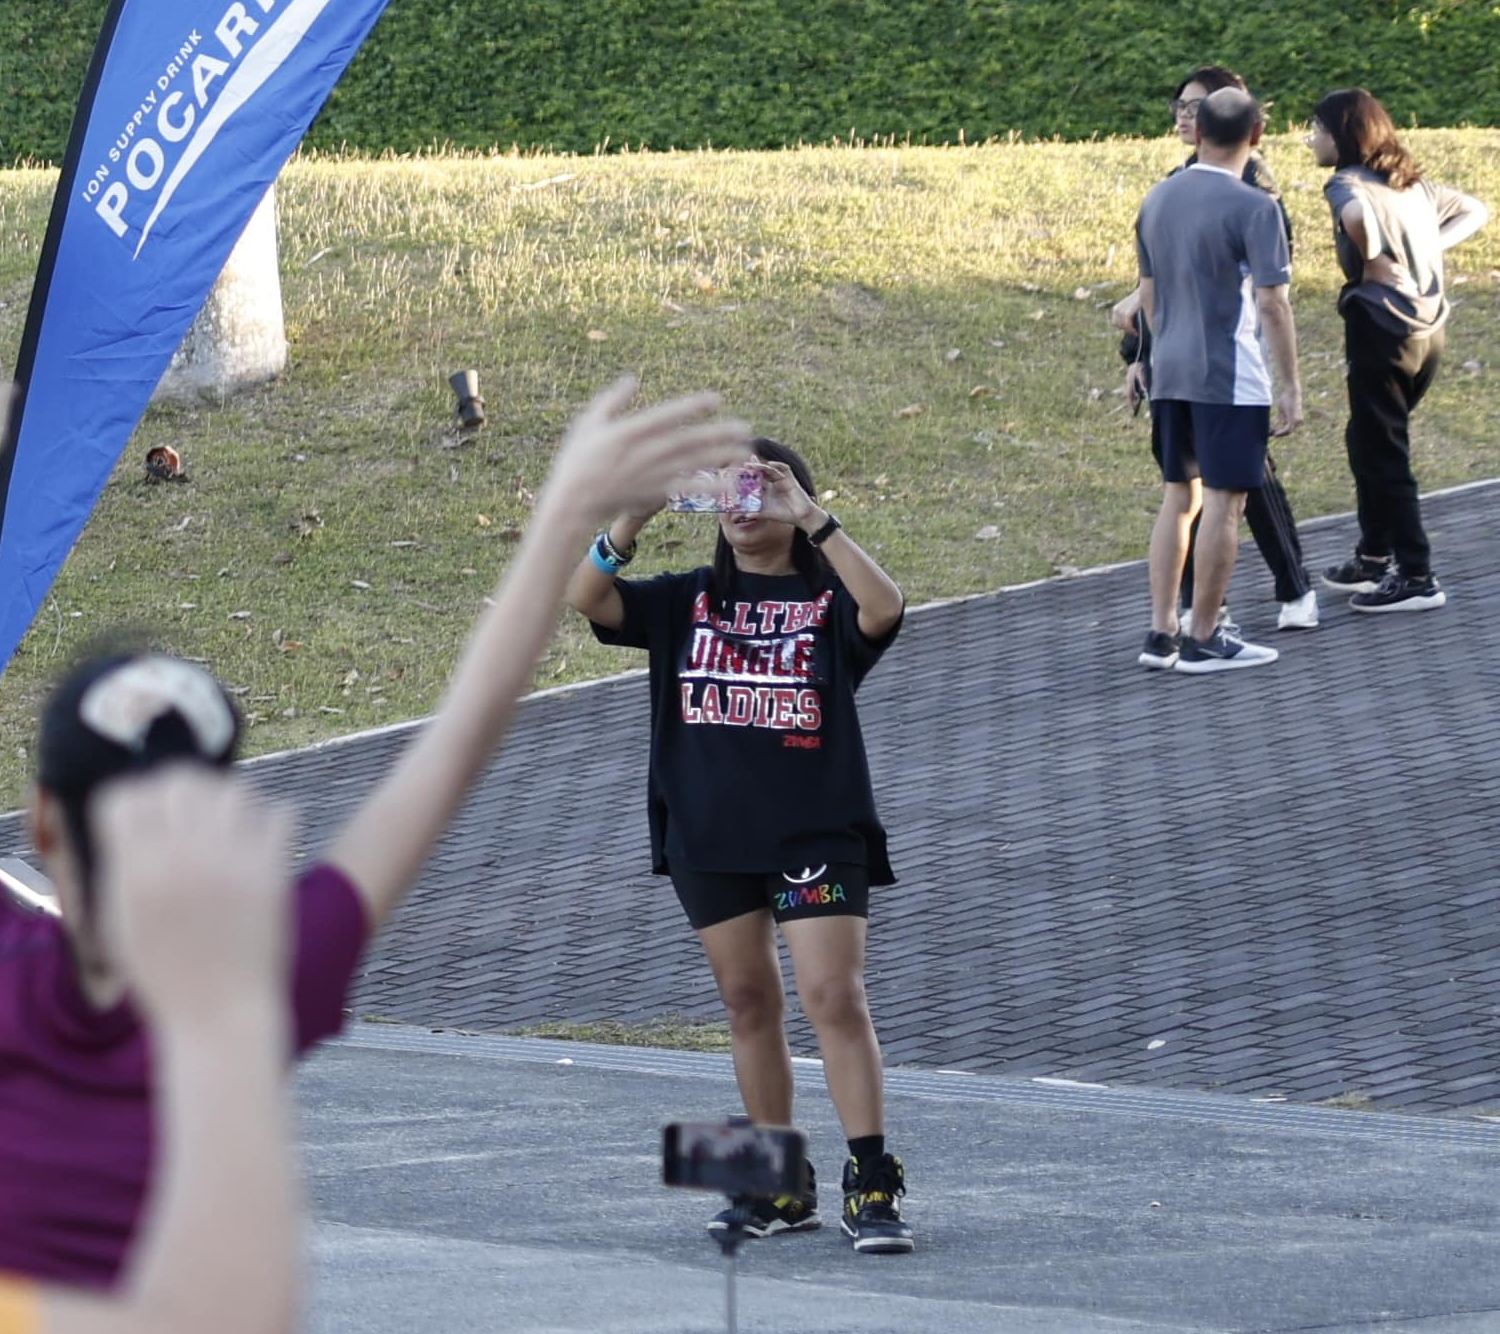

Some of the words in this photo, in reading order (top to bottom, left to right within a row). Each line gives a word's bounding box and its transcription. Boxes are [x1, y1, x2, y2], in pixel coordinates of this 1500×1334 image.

[82, 164, 110, 202] ION
[108, 90, 157, 162] SUPPLY
[157, 28, 202, 91] DRINK
[687, 630, 816, 679] JINGLE
[681, 682, 821, 730] LADIES
[774, 883, 847, 910] ZUMBA
